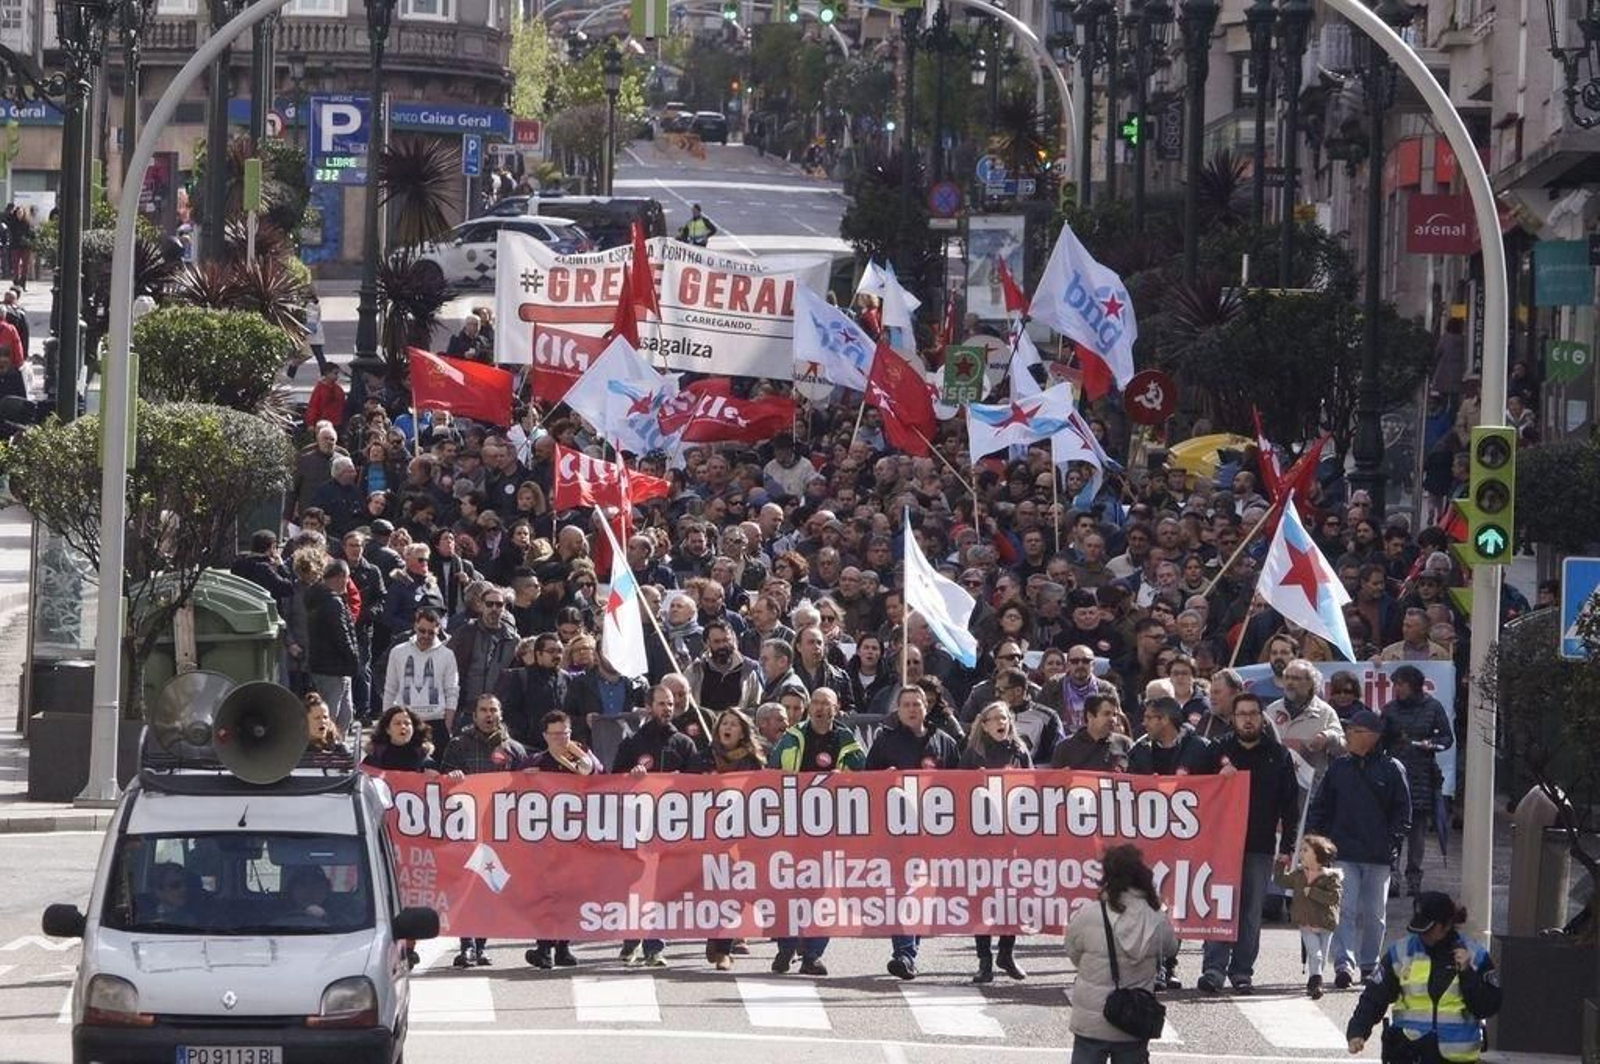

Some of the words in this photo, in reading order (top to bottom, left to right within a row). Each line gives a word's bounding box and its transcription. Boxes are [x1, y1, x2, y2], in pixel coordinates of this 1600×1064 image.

[10, 105, 46, 118] Geral
[420, 111, 454, 125] Caixa
[458, 114, 491, 127] Geral
[321, 103, 361, 152] P
[315, 169, 339, 181] 232
[325, 157, 357, 168] LIBRE
[1414, 223, 1466, 237] arenal
[678, 266, 794, 317] GERAL
[535, 332, 590, 372] CIG
[493, 775, 872, 847] recuperación
[886, 774, 956, 837] de
[970, 774, 1200, 841] dereitos
[398, 866, 438, 889] ASE
[702, 852, 757, 892] Na
[769, 849, 892, 892] Galiza
[904, 857, 1104, 898] empregos
[579, 892, 743, 934] salarios
[753, 898, 777, 930] e
[788, 885, 970, 938] pensións
